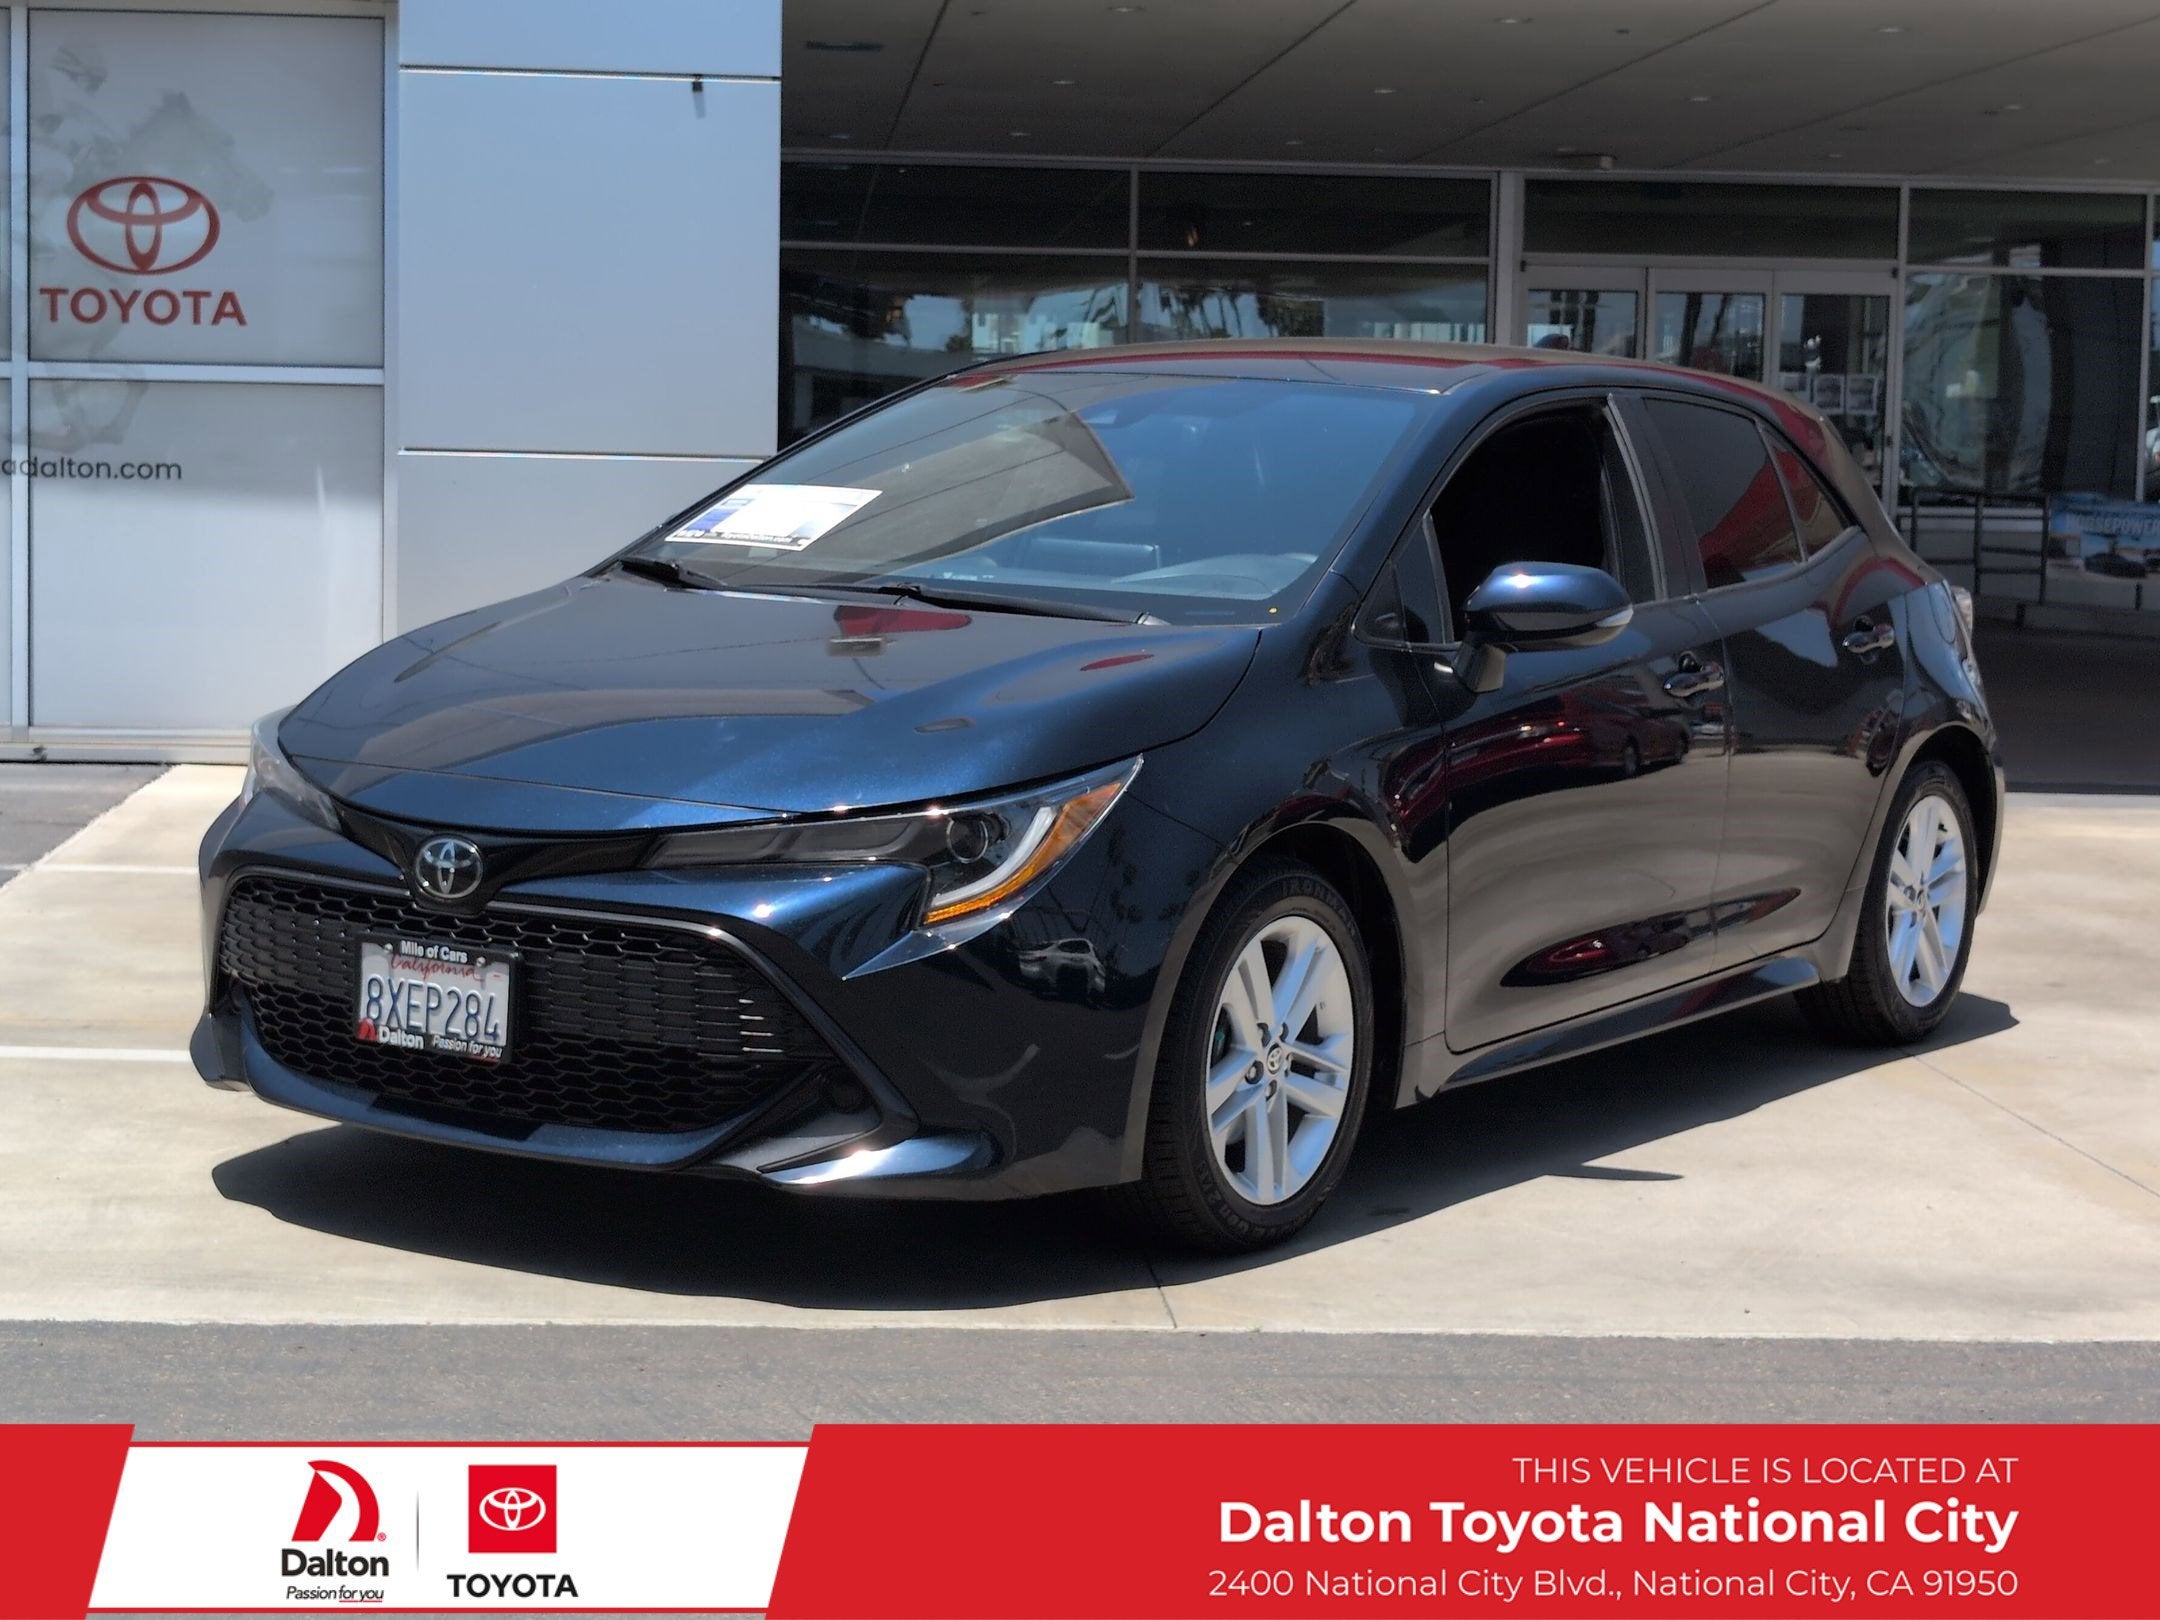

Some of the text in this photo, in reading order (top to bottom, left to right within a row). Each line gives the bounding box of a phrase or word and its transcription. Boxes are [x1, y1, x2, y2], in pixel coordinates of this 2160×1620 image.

[39, 287, 248, 326] TOYOTA
[401, 940, 468, 963] Mile of Cars
[390, 954, 484, 981] California
[366, 973, 500, 1041] 8XEP284
[378, 1026, 424, 1049] Dalton
[432, 1034, 503, 1060] Passion for you
